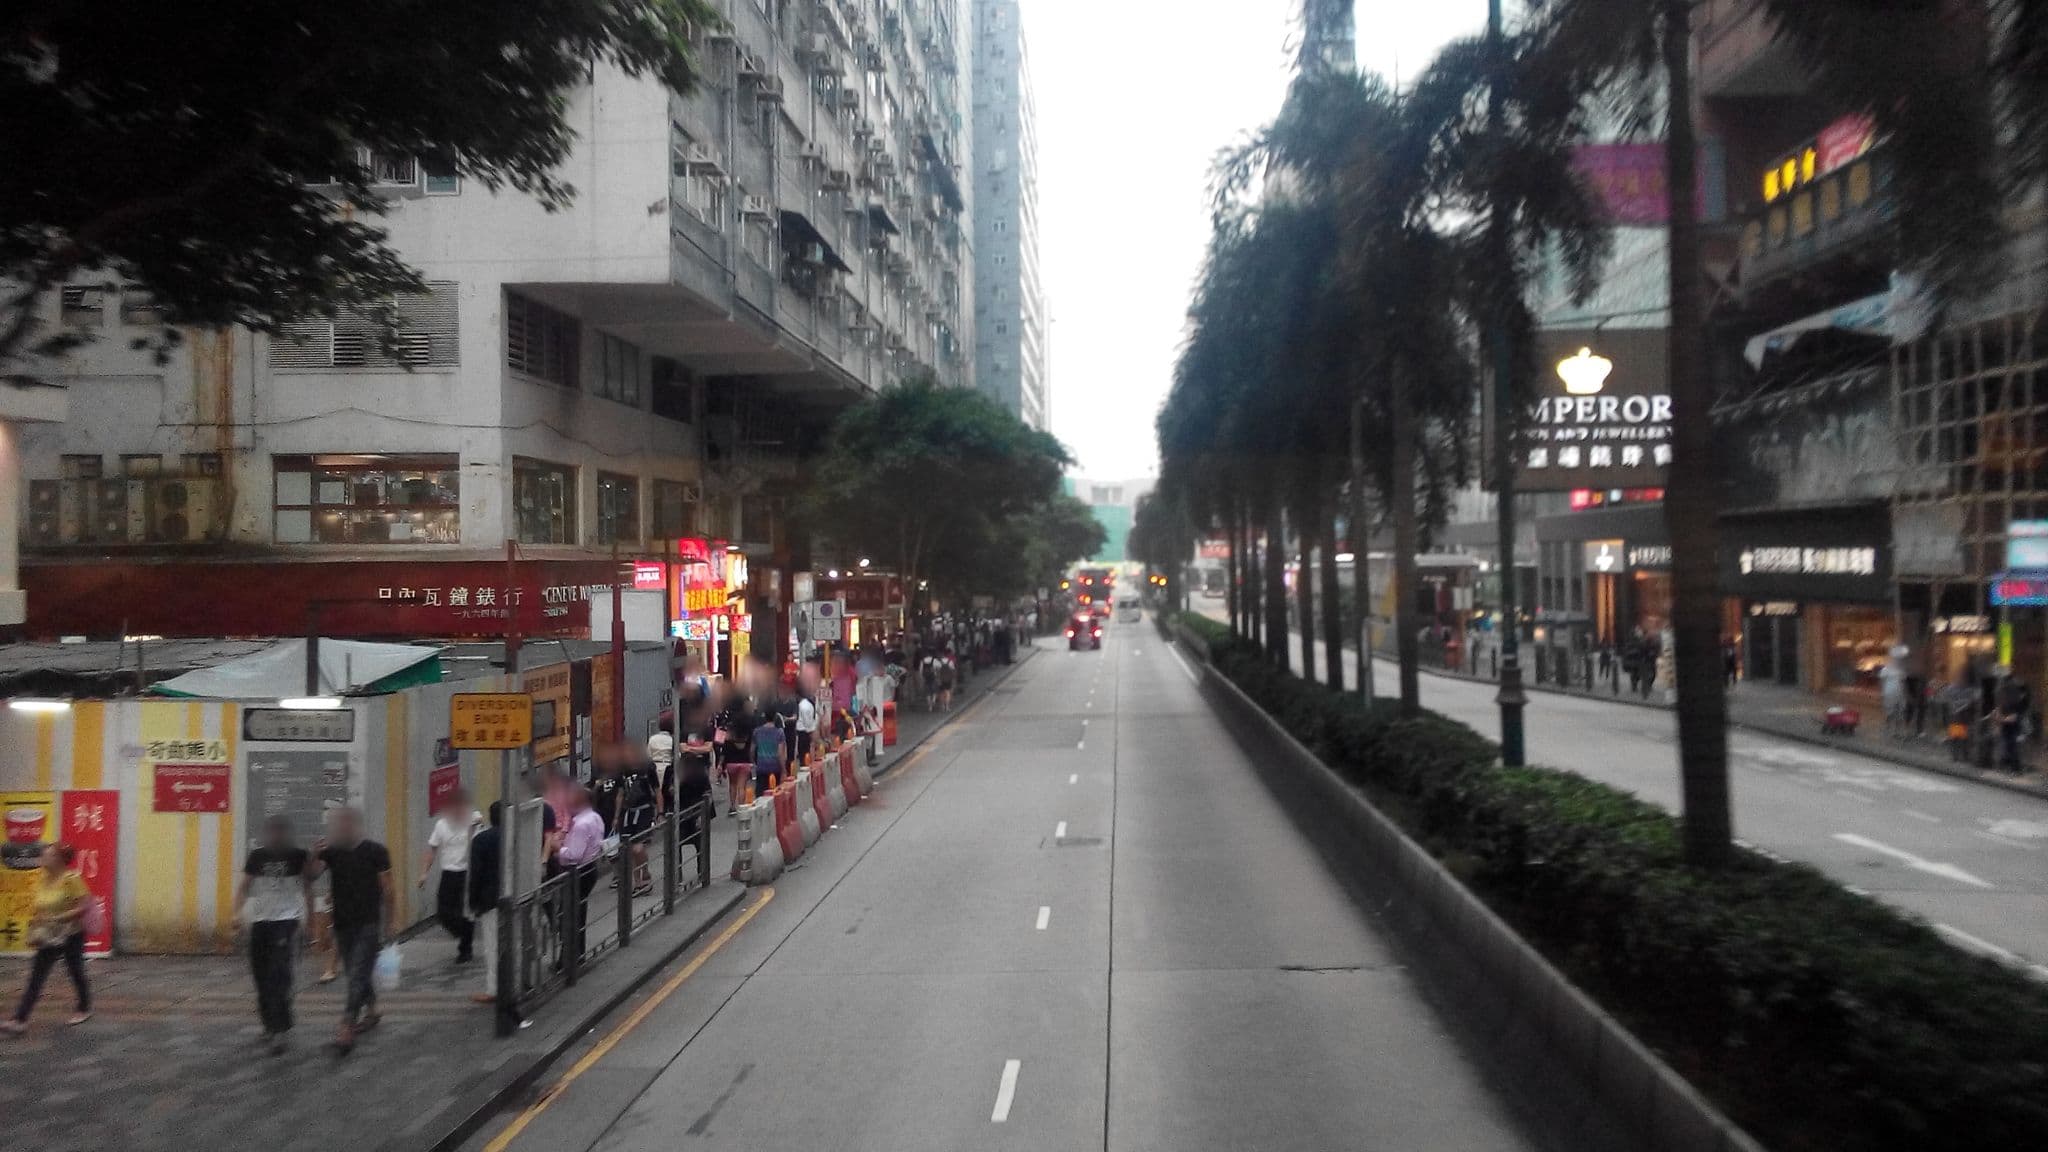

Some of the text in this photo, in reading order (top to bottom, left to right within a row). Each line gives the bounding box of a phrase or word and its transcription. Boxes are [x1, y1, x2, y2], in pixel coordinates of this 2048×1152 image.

[1526, 394, 1673, 424] MPEROR
[456, 700, 528, 711] DIVERSION
[474, 713, 508, 725] ENDS
